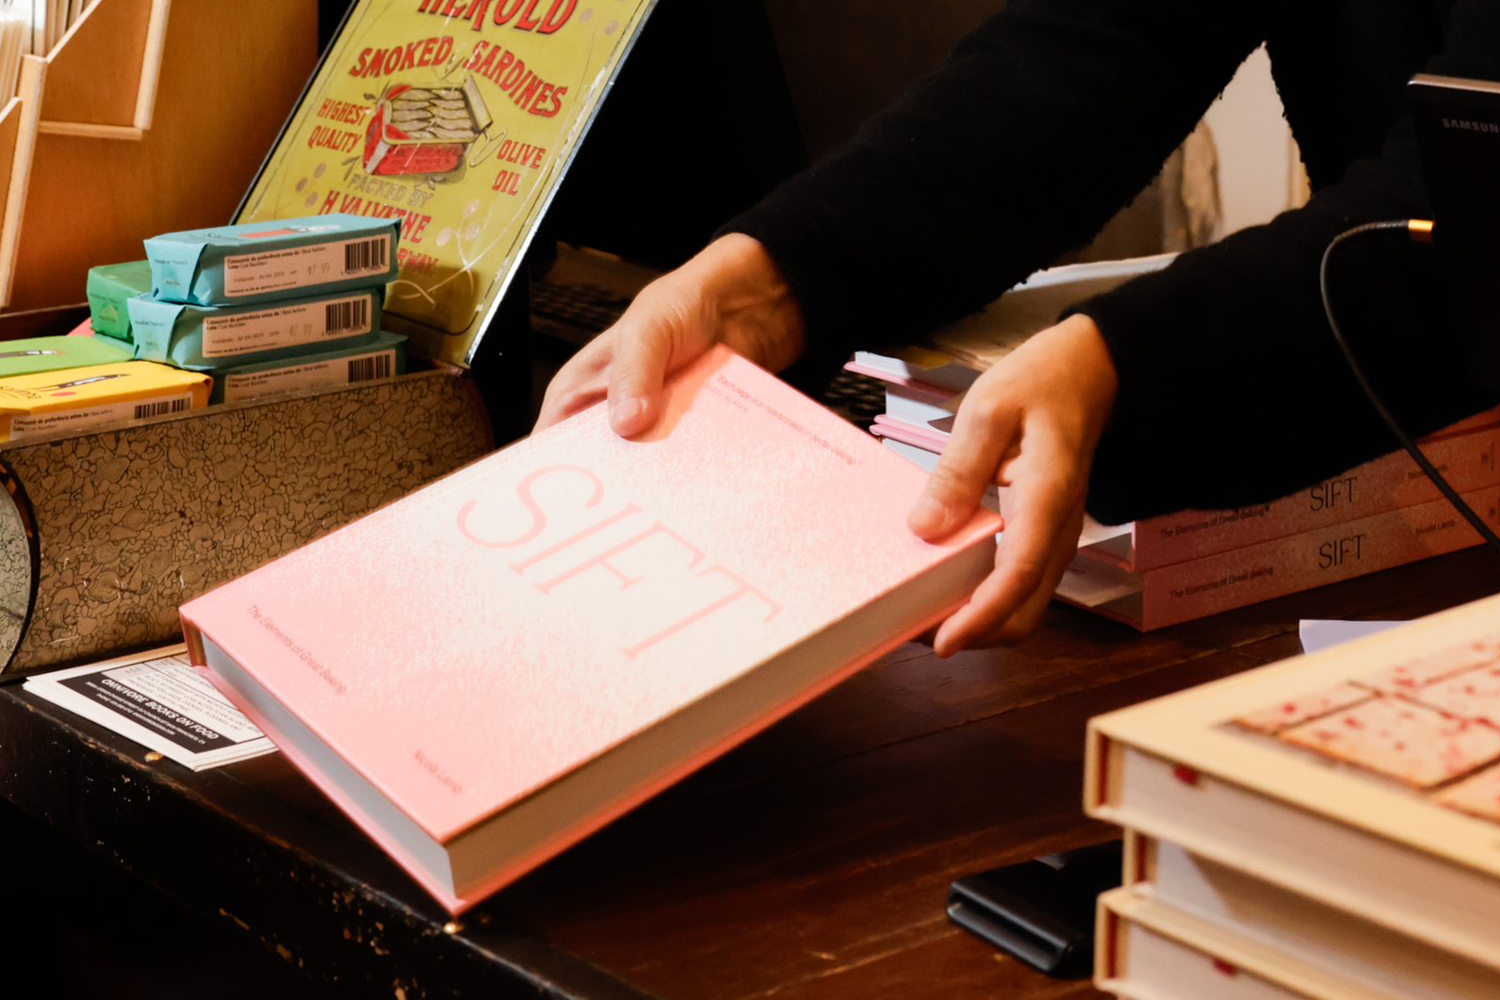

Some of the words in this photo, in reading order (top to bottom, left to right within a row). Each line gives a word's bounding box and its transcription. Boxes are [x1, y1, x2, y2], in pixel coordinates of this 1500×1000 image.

[349, 36, 454, 79] SMOKED
[462, 40, 569, 119] SARDINES
[317, 98, 372, 126] HIGHEST
[307, 125, 364, 153] QUALITY
[496, 139, 546, 170] OLIVE
[347, 173, 408, 202] PACKED
[407, 189, 434, 208] BY
[491, 169, 521, 196] OIL
[1309, 476, 1359, 512] SIFT
[1160, 527, 1174, 540] The
[456, 464, 785, 662] SIFT
[1318, 533, 1367, 570] SIFT
[1170, 588, 1185, 600] The
[248, 604, 263, 620] The
[259, 616, 295, 649] Elements
[101, 678, 150, 704] OMNIVORE
[144, 697, 179, 720] BOOKS
[175, 716, 194, 730] ON
[192, 723, 220, 741] FOOD
